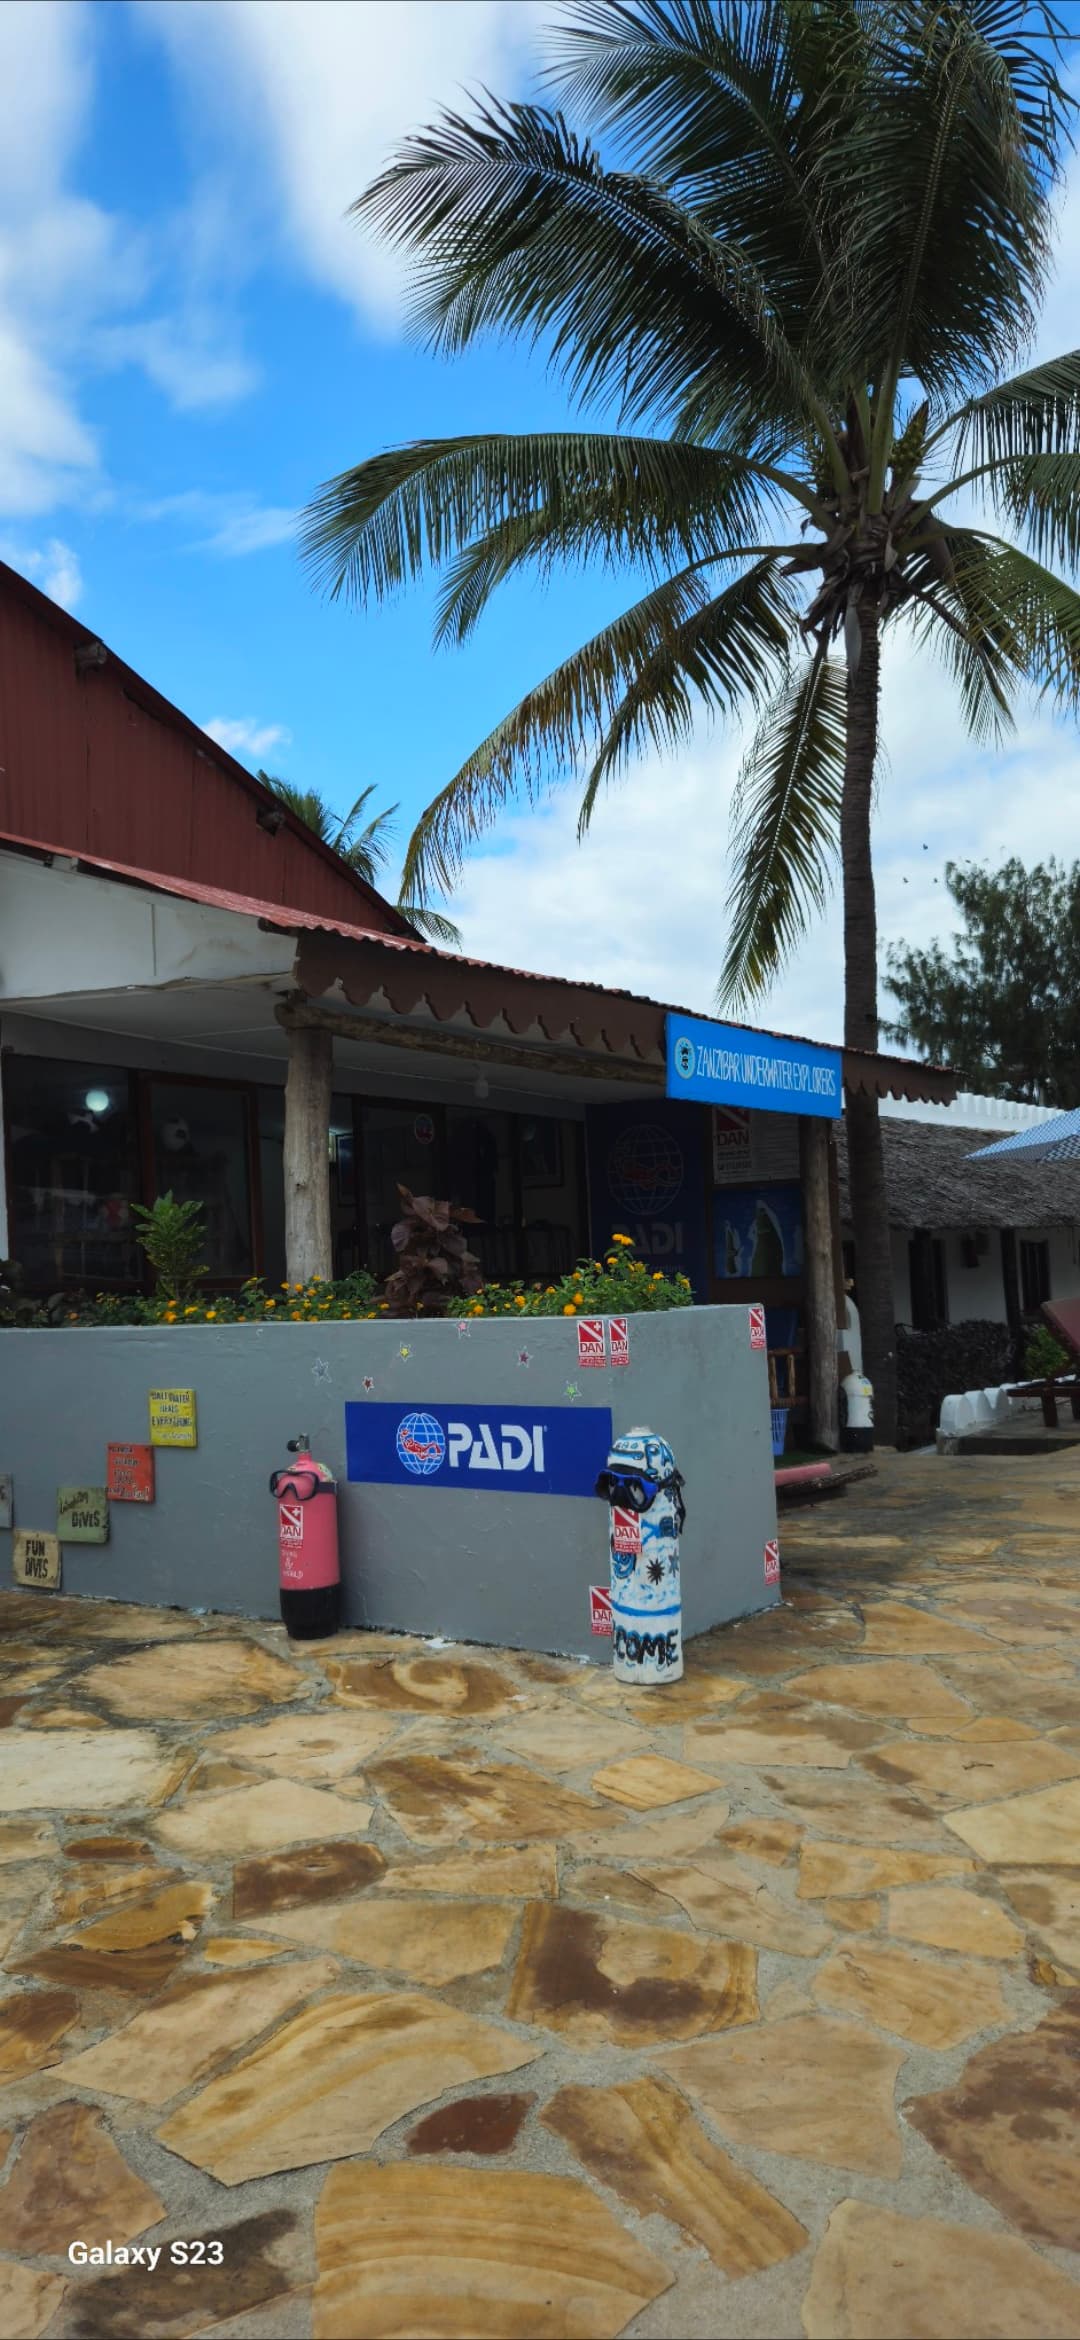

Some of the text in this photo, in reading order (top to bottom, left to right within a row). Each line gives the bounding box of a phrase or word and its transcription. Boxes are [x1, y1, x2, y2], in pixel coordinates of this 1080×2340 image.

[696, 1046, 836, 1097] ZANZIBAR UNDERWATER EXPLORERS
[717, 1129, 750, 1146] DAN
[580, 1342, 604, 1353] DAN
[611, 1341, 628, 1352] DAN
[448, 1422, 545, 1473] PADI
[615, 1526, 640, 1539] DAN
[25, 1539, 46, 1557] FUN
